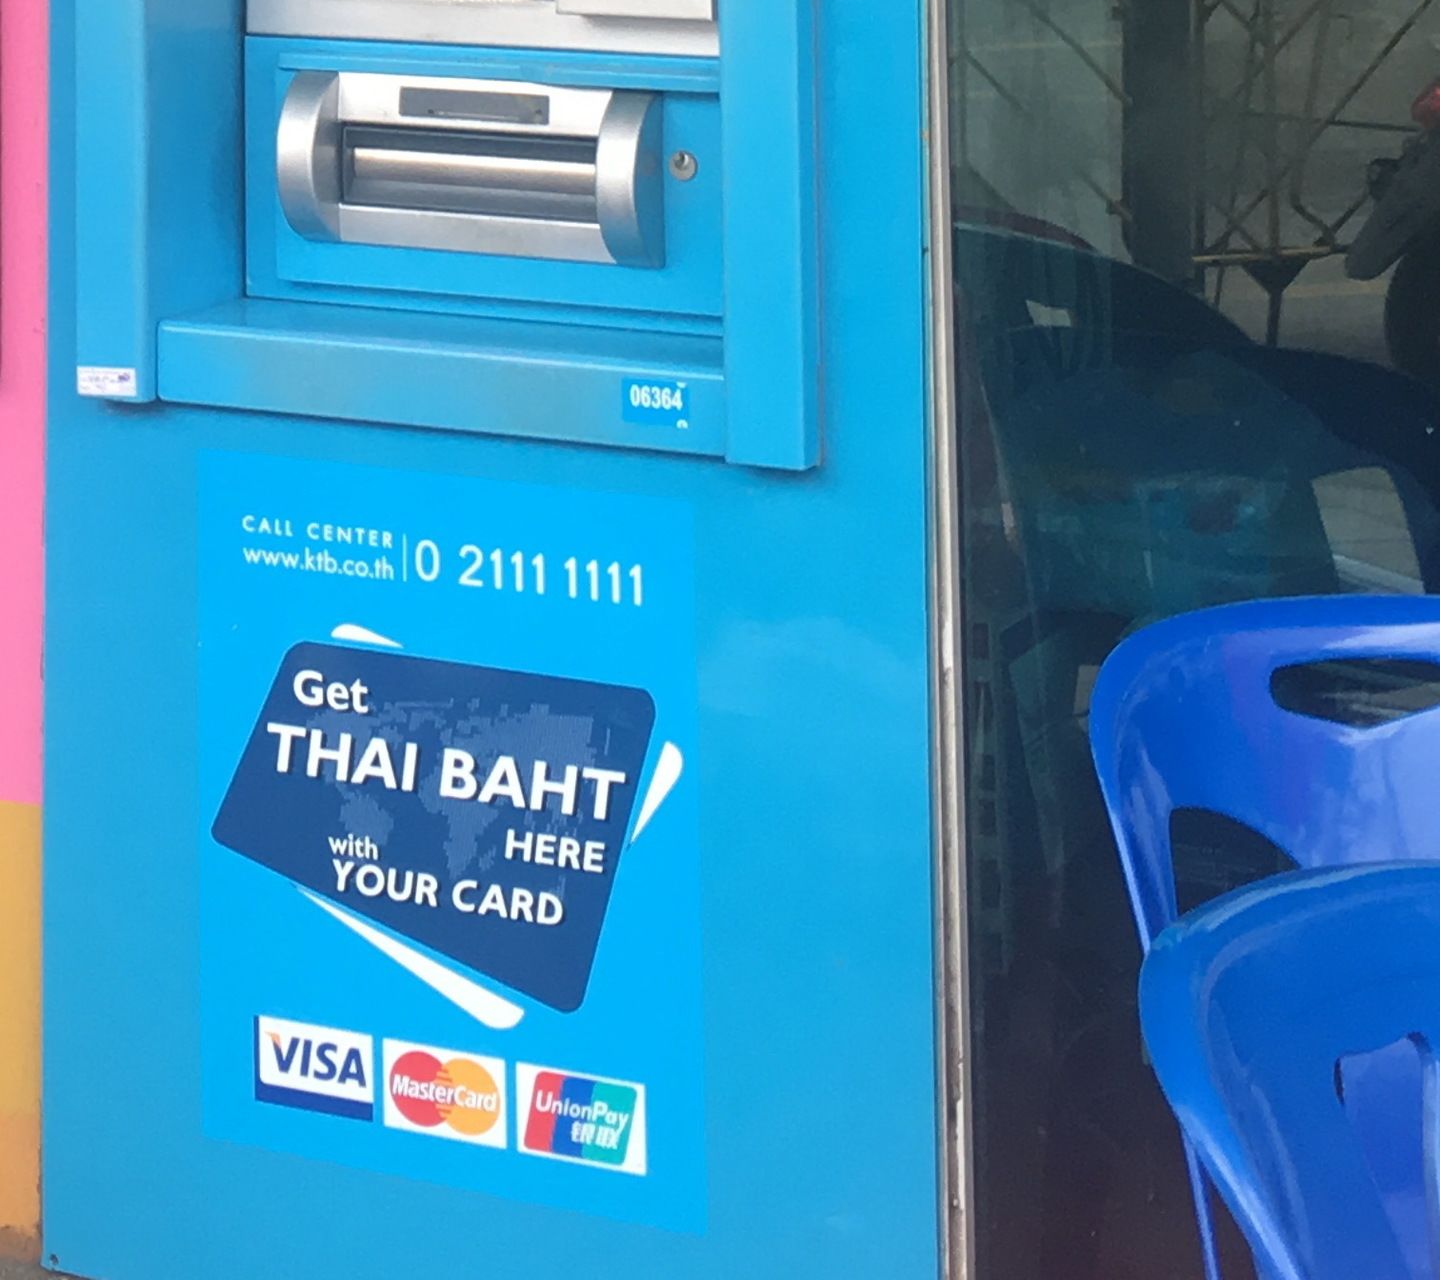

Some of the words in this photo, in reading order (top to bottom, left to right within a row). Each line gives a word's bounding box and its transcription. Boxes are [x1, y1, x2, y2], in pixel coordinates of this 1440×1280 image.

[629, 384, 683, 411] 06364
[241, 514, 293, 538] CALL
[307, 522, 394, 549] CENTER
[242, 546, 394, 581] www.ktb.co.th
[415, 539, 440, 582] 0
[458, 544, 546, 595] 2111
[563, 556, 643, 607] 1111
[292, 669, 369, 714] Get
[266, 722, 419, 792] THAI
[438, 747, 626, 821] BAHT
[328, 833, 379, 861] with
[504, 828, 606, 874] HERE
[331, 858, 440, 908] YOUR
[451, 880, 565, 926] CARD
[265, 1031, 368, 1088] VISA
[392, 1075, 498, 1112] MasterCard
[535, 1090, 629, 1135] UnionPay
